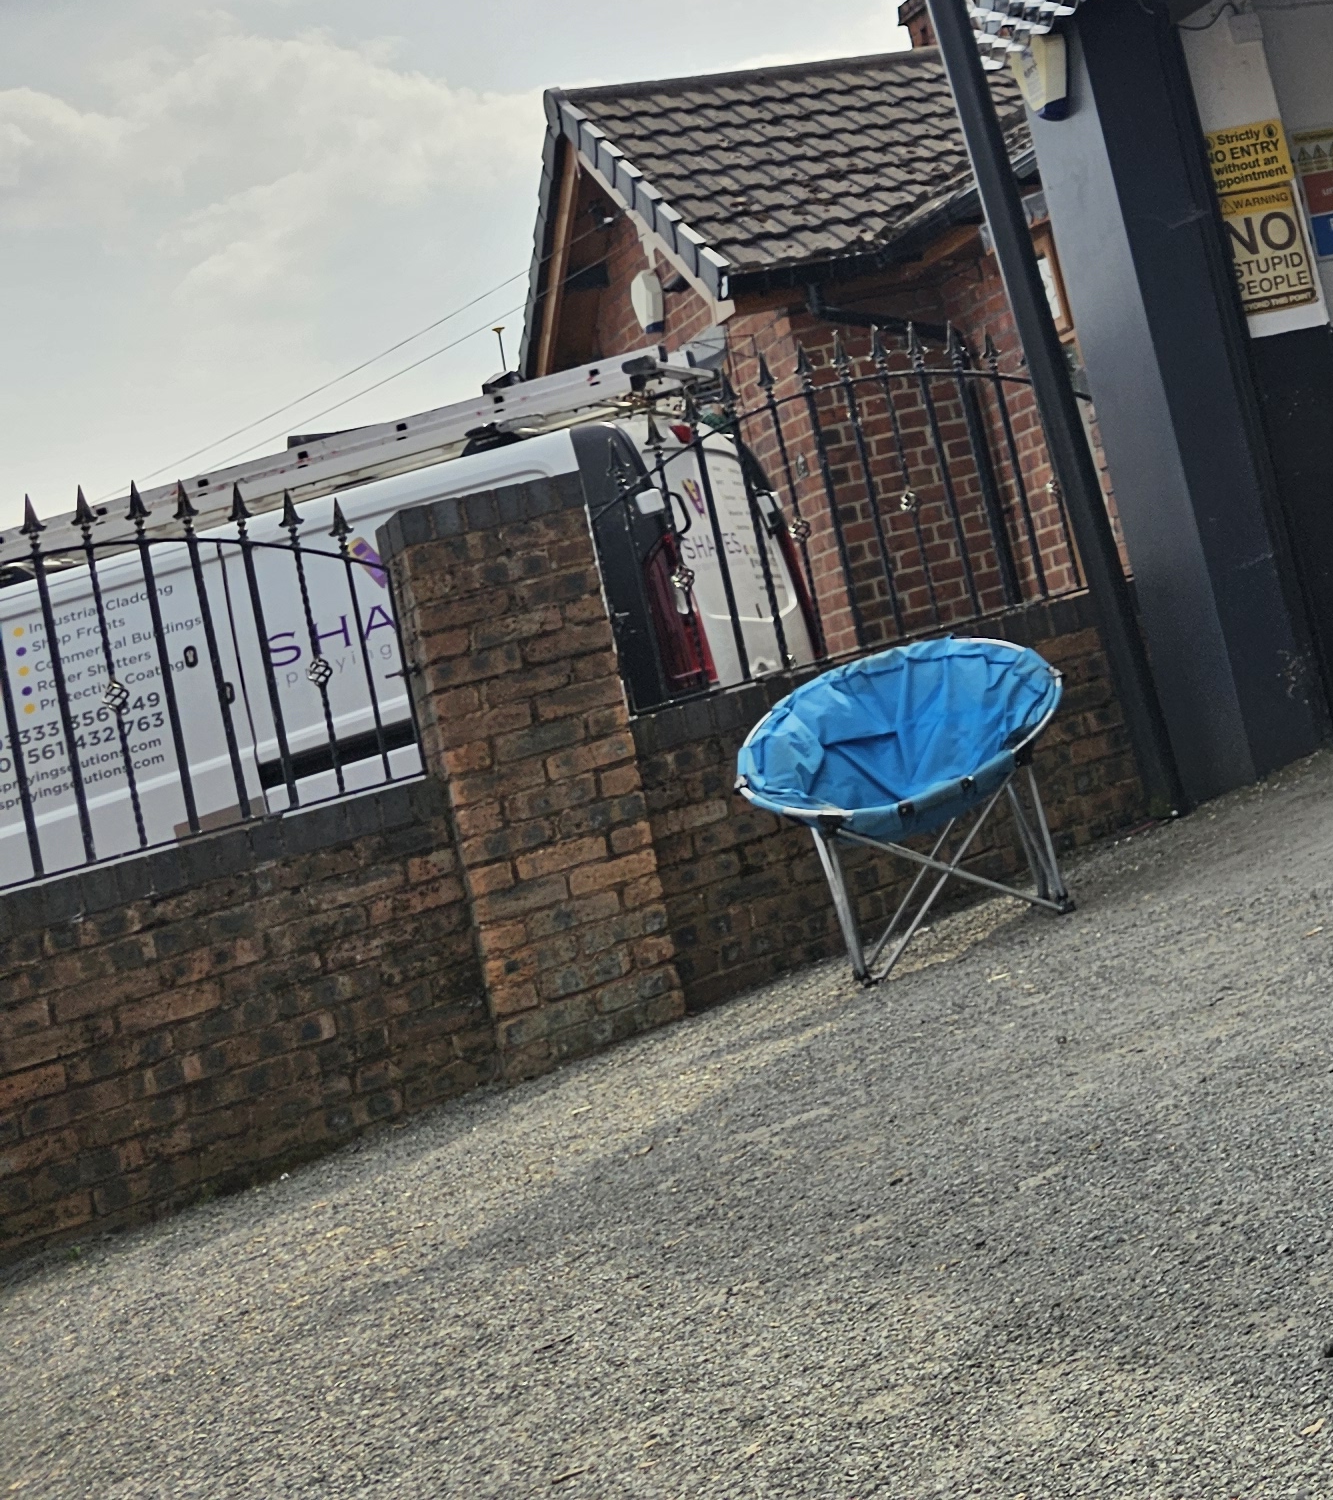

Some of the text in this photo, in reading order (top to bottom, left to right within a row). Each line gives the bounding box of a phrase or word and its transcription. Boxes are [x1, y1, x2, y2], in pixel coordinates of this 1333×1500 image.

[1217, 128, 1260, 146] Strictly
[1230, 138, 1279, 161] ENTRY
[1214, 155, 1279, 176] without an
[1216, 164, 1288, 190] ppointment
[1233, 192, 1288, 209] WARNING
[37, 651, 152, 692] Roer Shtters
[125, 660, 185, 684] Coatng
[0, 711, 165, 773] 0561 432 763
